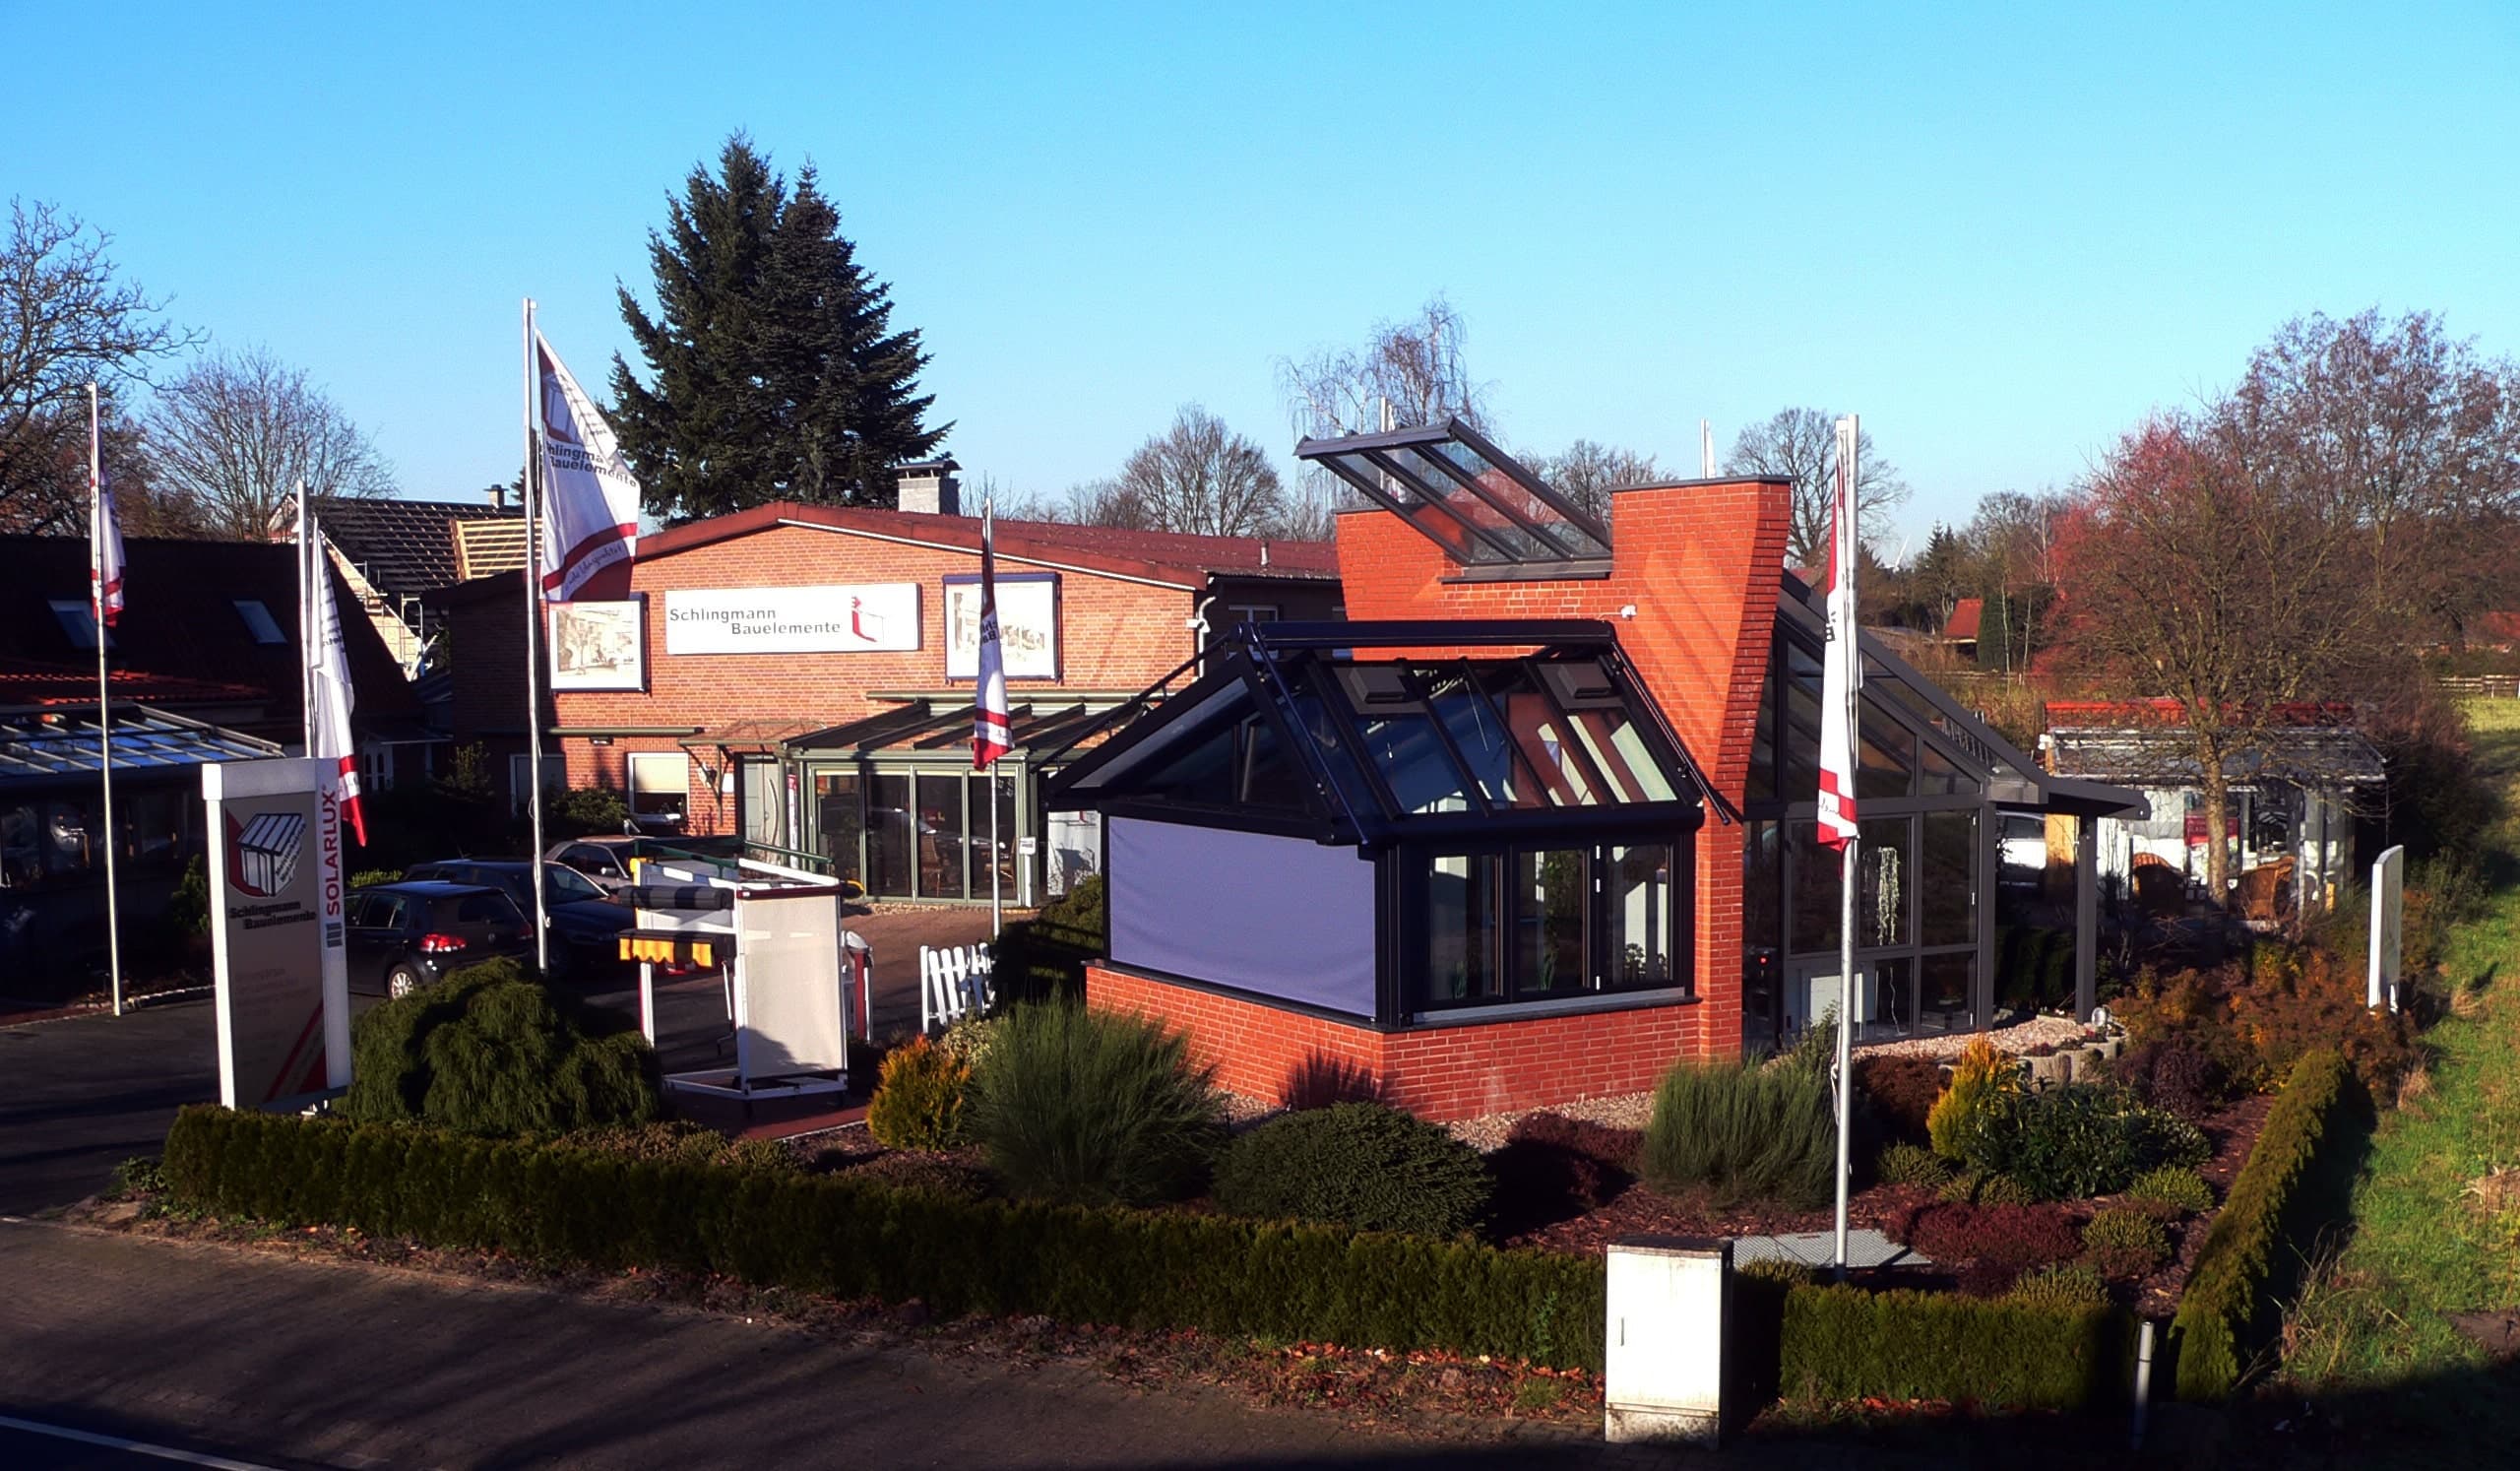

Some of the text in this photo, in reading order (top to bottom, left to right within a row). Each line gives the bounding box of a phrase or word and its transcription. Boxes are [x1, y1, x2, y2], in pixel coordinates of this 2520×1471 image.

[546, 440, 604, 464] hlingma
[669, 608, 776, 623] Schlingmann
[731, 622, 841, 635] Bauelemente
[322, 791, 341, 917] SOLARLUX
[228, 901, 301, 919] Schlingmann
[243, 911, 317, 930] Bauelemente
